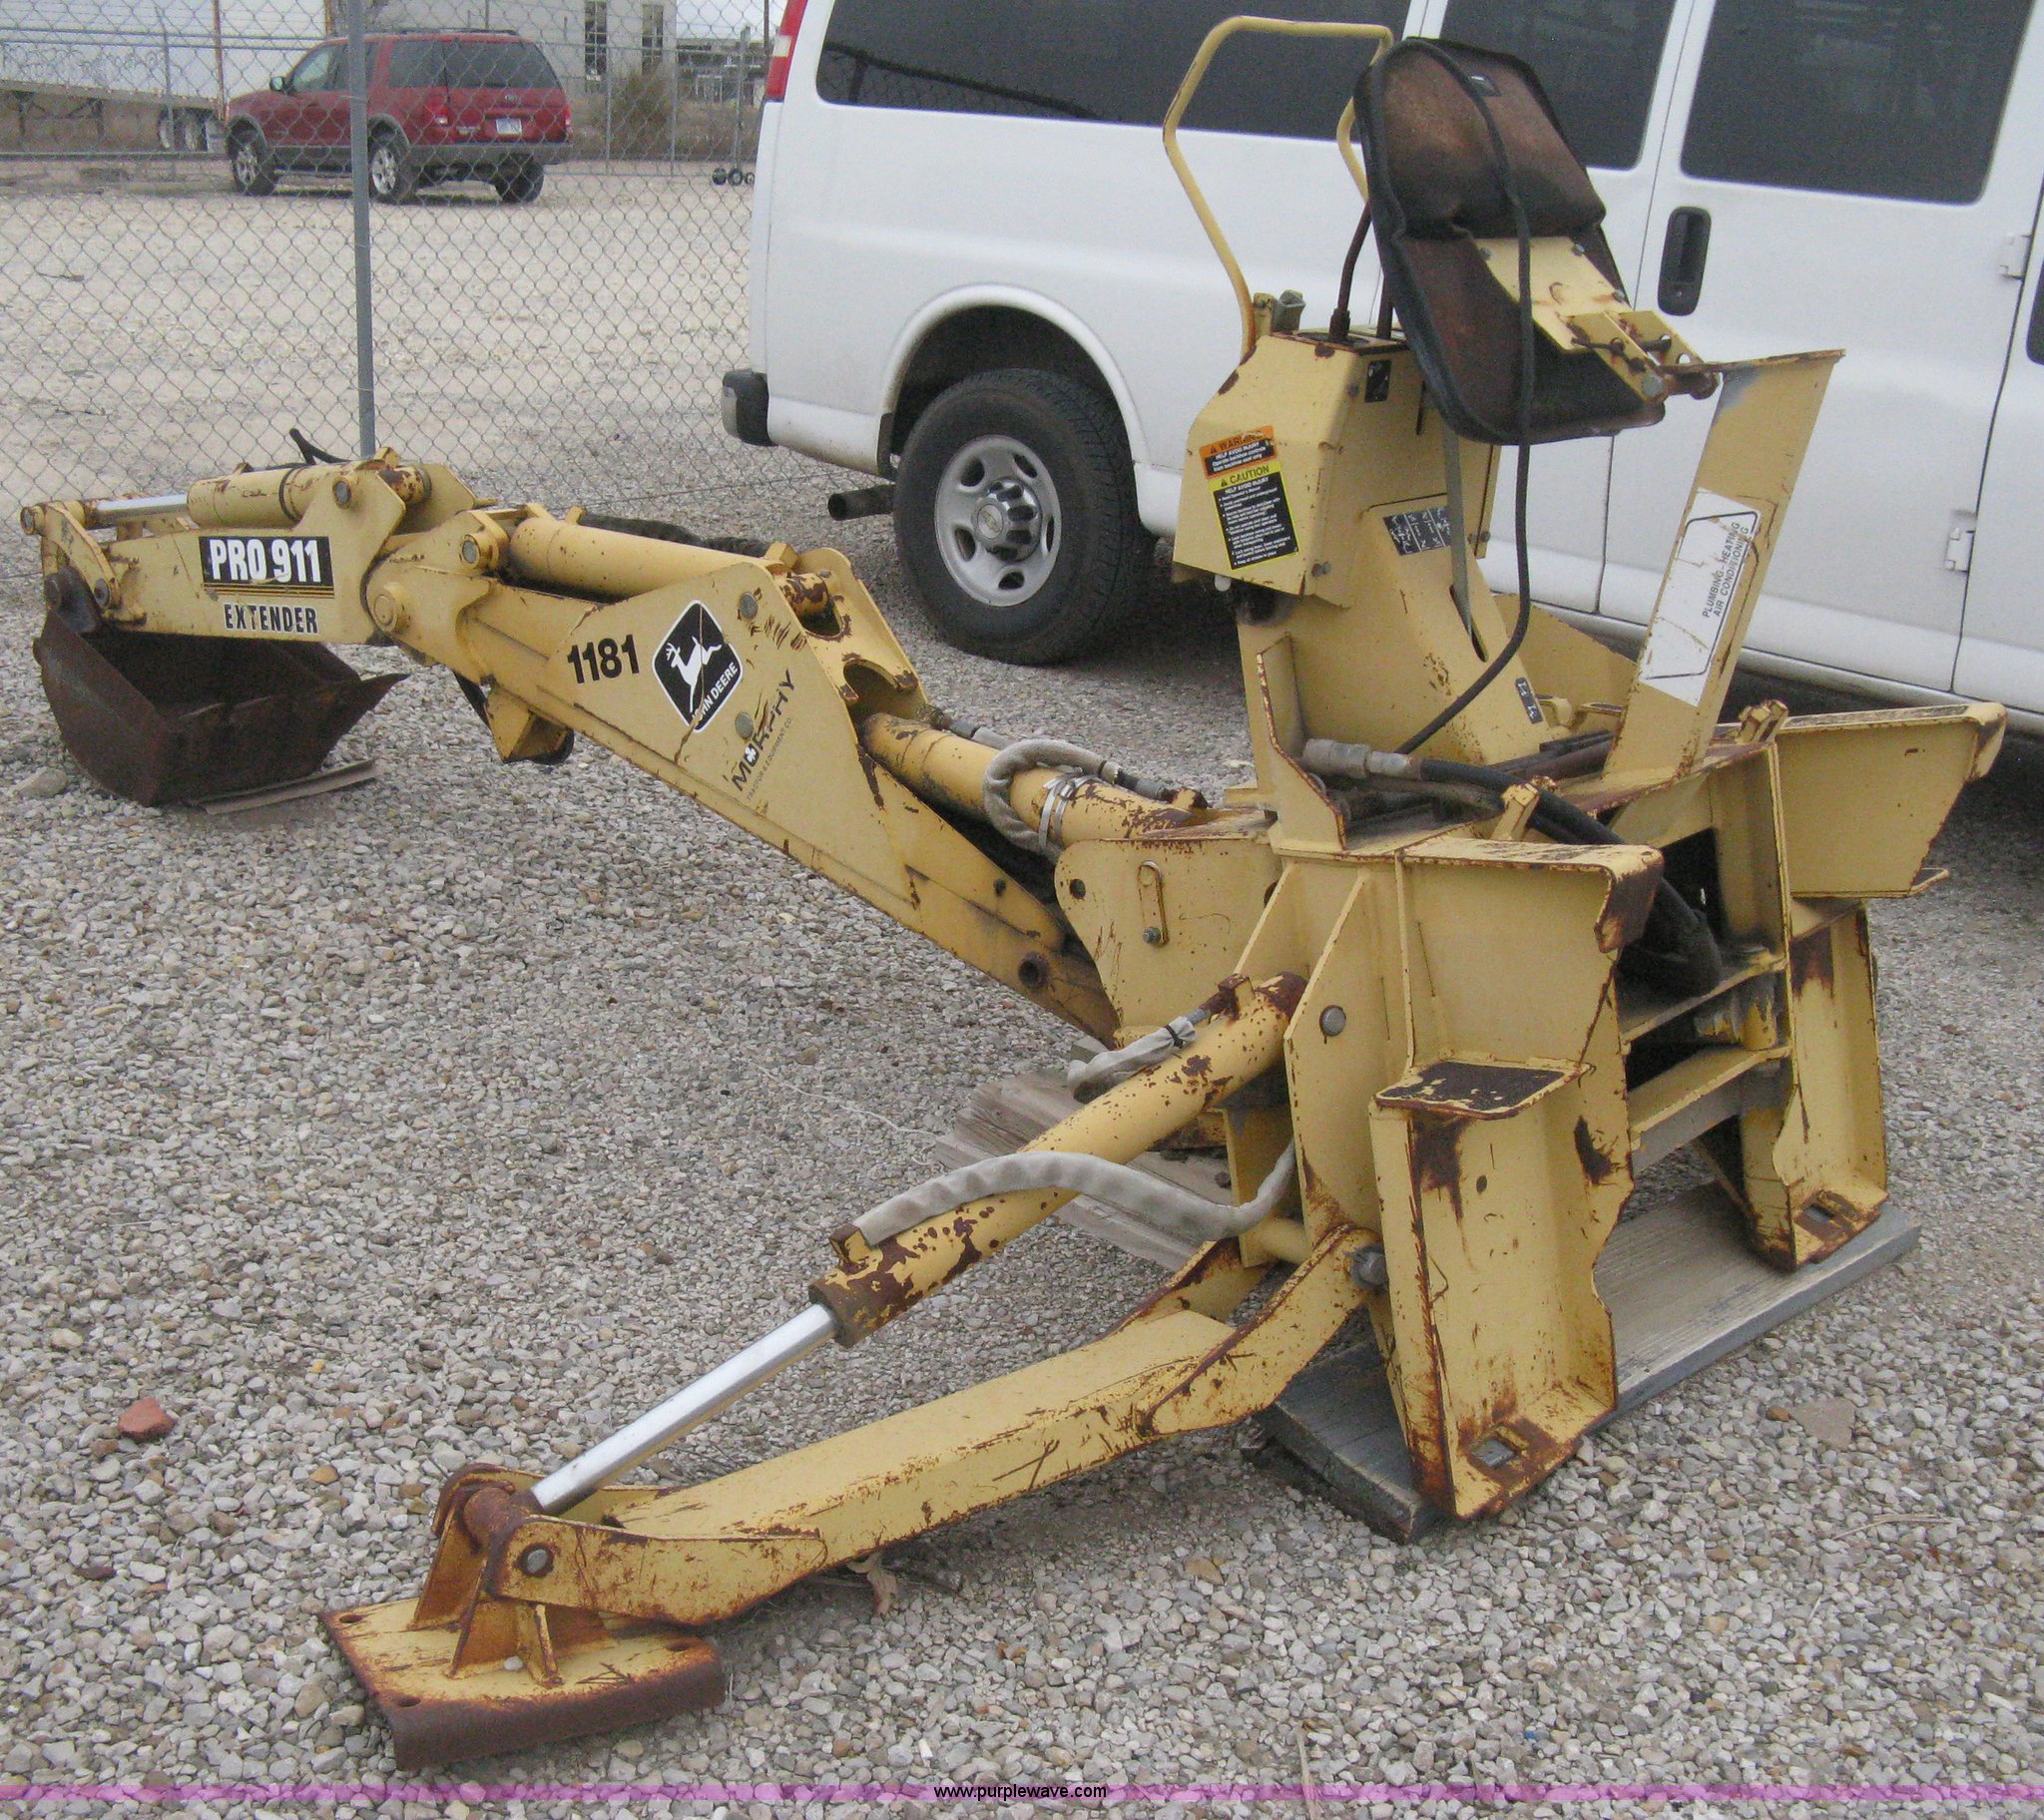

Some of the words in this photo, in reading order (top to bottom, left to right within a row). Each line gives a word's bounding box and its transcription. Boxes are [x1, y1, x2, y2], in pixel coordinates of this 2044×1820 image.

[1230, 465, 1270, 485] CAUTION
[210, 539, 267, 582] PRO
[271, 539, 321, 583] 911
[1702, 571, 1724, 617] PLUMBING
[1721, 522, 1740, 564] HEATING
[224, 604, 318, 634] EXTENDER
[1714, 601, 1725, 617] AIR
[567, 635, 640, 683] 1181
[692, 695, 713, 722] OHN
[712, 662, 738, 700] DEERE
